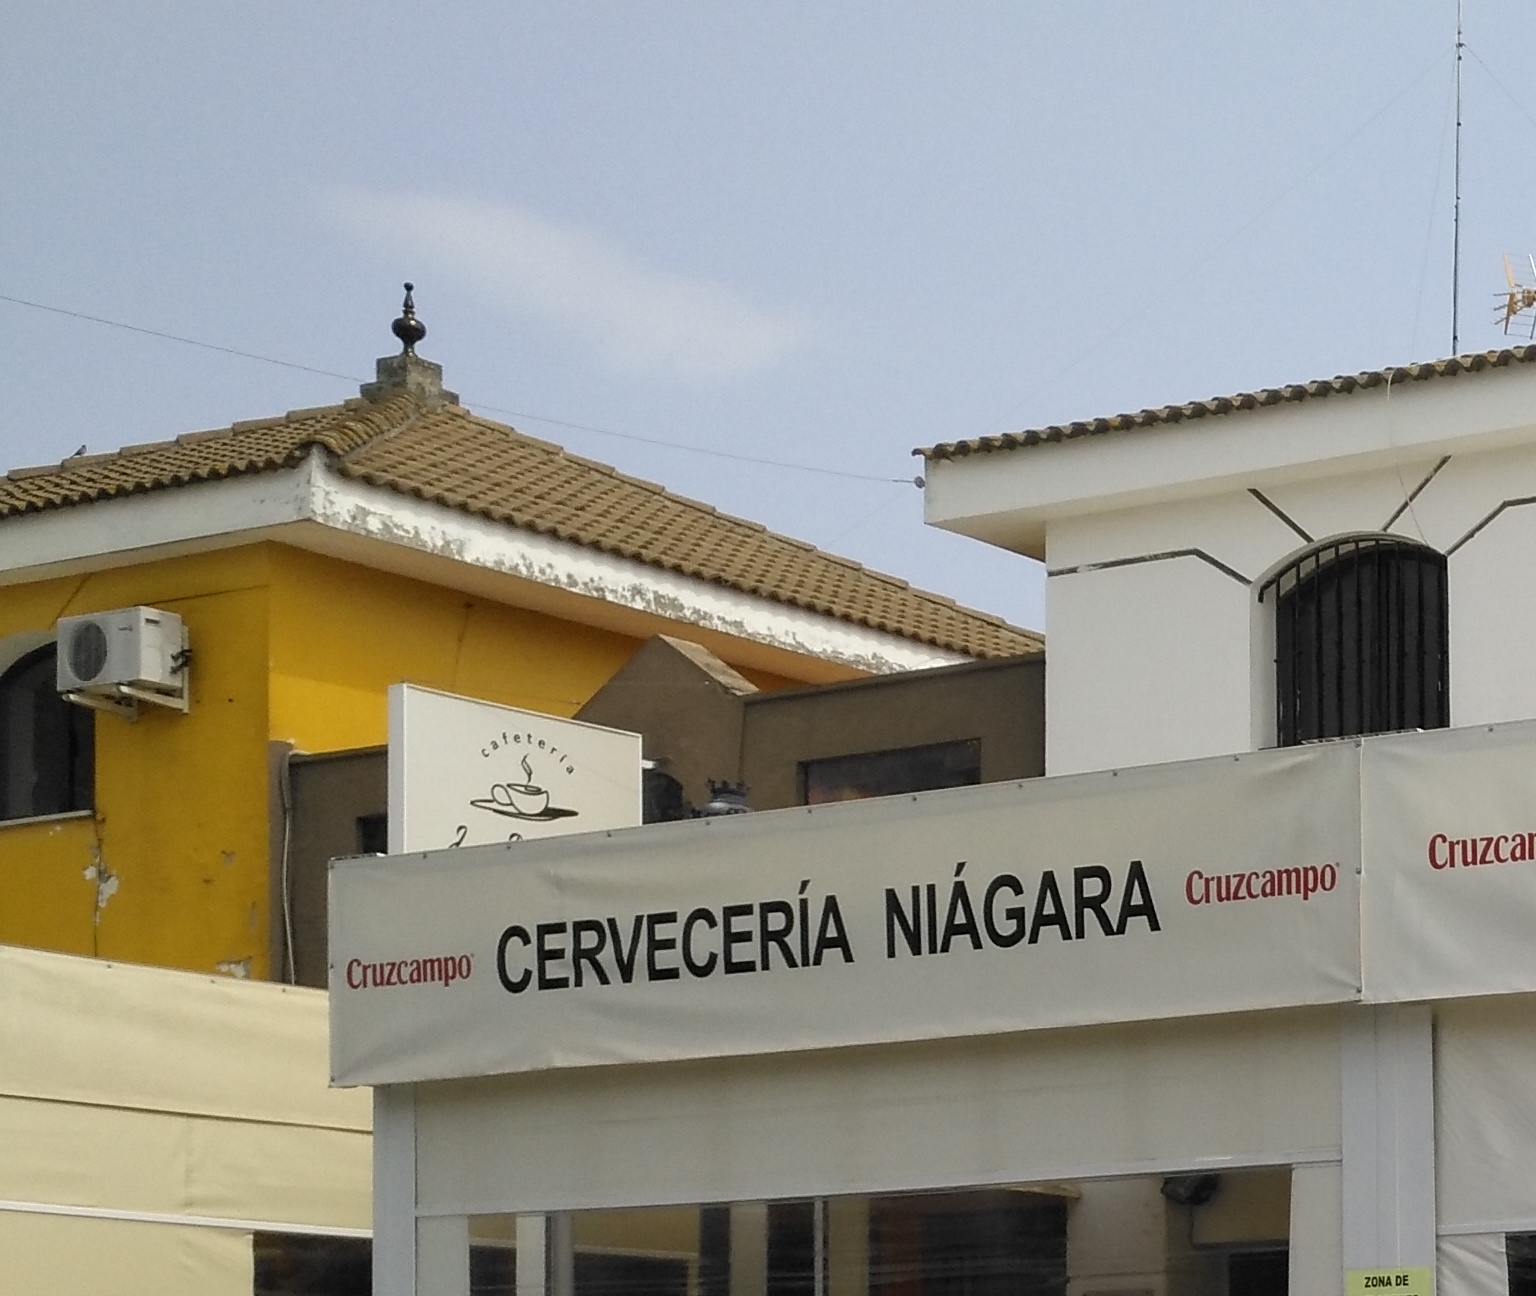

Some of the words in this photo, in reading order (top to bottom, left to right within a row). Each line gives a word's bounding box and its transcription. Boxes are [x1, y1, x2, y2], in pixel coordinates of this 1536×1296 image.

[1185, 864, 1337, 905] Cruzcampo
[496, 879, 855, 994] CERVECERÍA
[884, 860, 1161, 958] NIÁGARA
[346, 953, 472, 990] Cruzcampo
[1364, 1276, 1392, 1288] ZONA
[1395, 1275, 1409, 1286] DE
